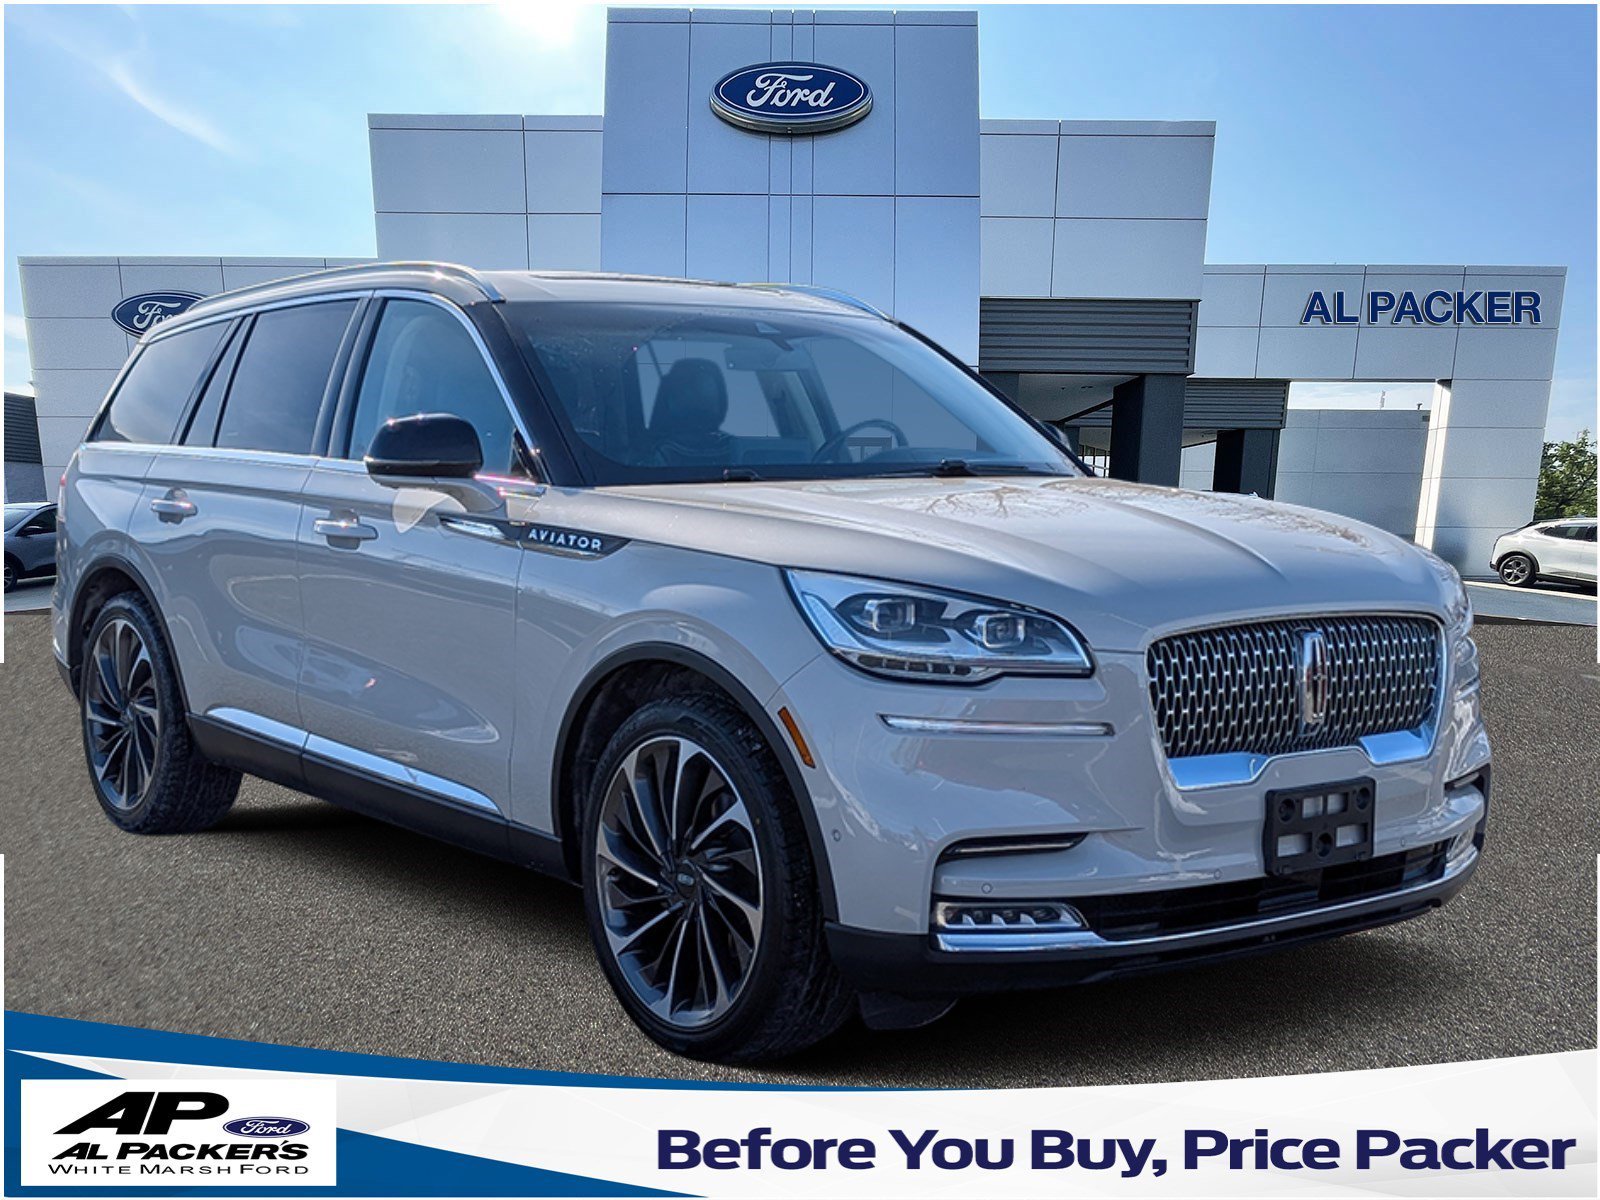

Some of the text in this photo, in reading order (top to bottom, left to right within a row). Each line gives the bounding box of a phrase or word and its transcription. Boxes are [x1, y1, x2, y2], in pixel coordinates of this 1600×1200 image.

[746, 73, 836, 107] Ford
[132, 300, 182, 329] Fo
[1301, 290, 1542, 325] AL PACKER
[527, 527, 602, 551] AVIATOR
